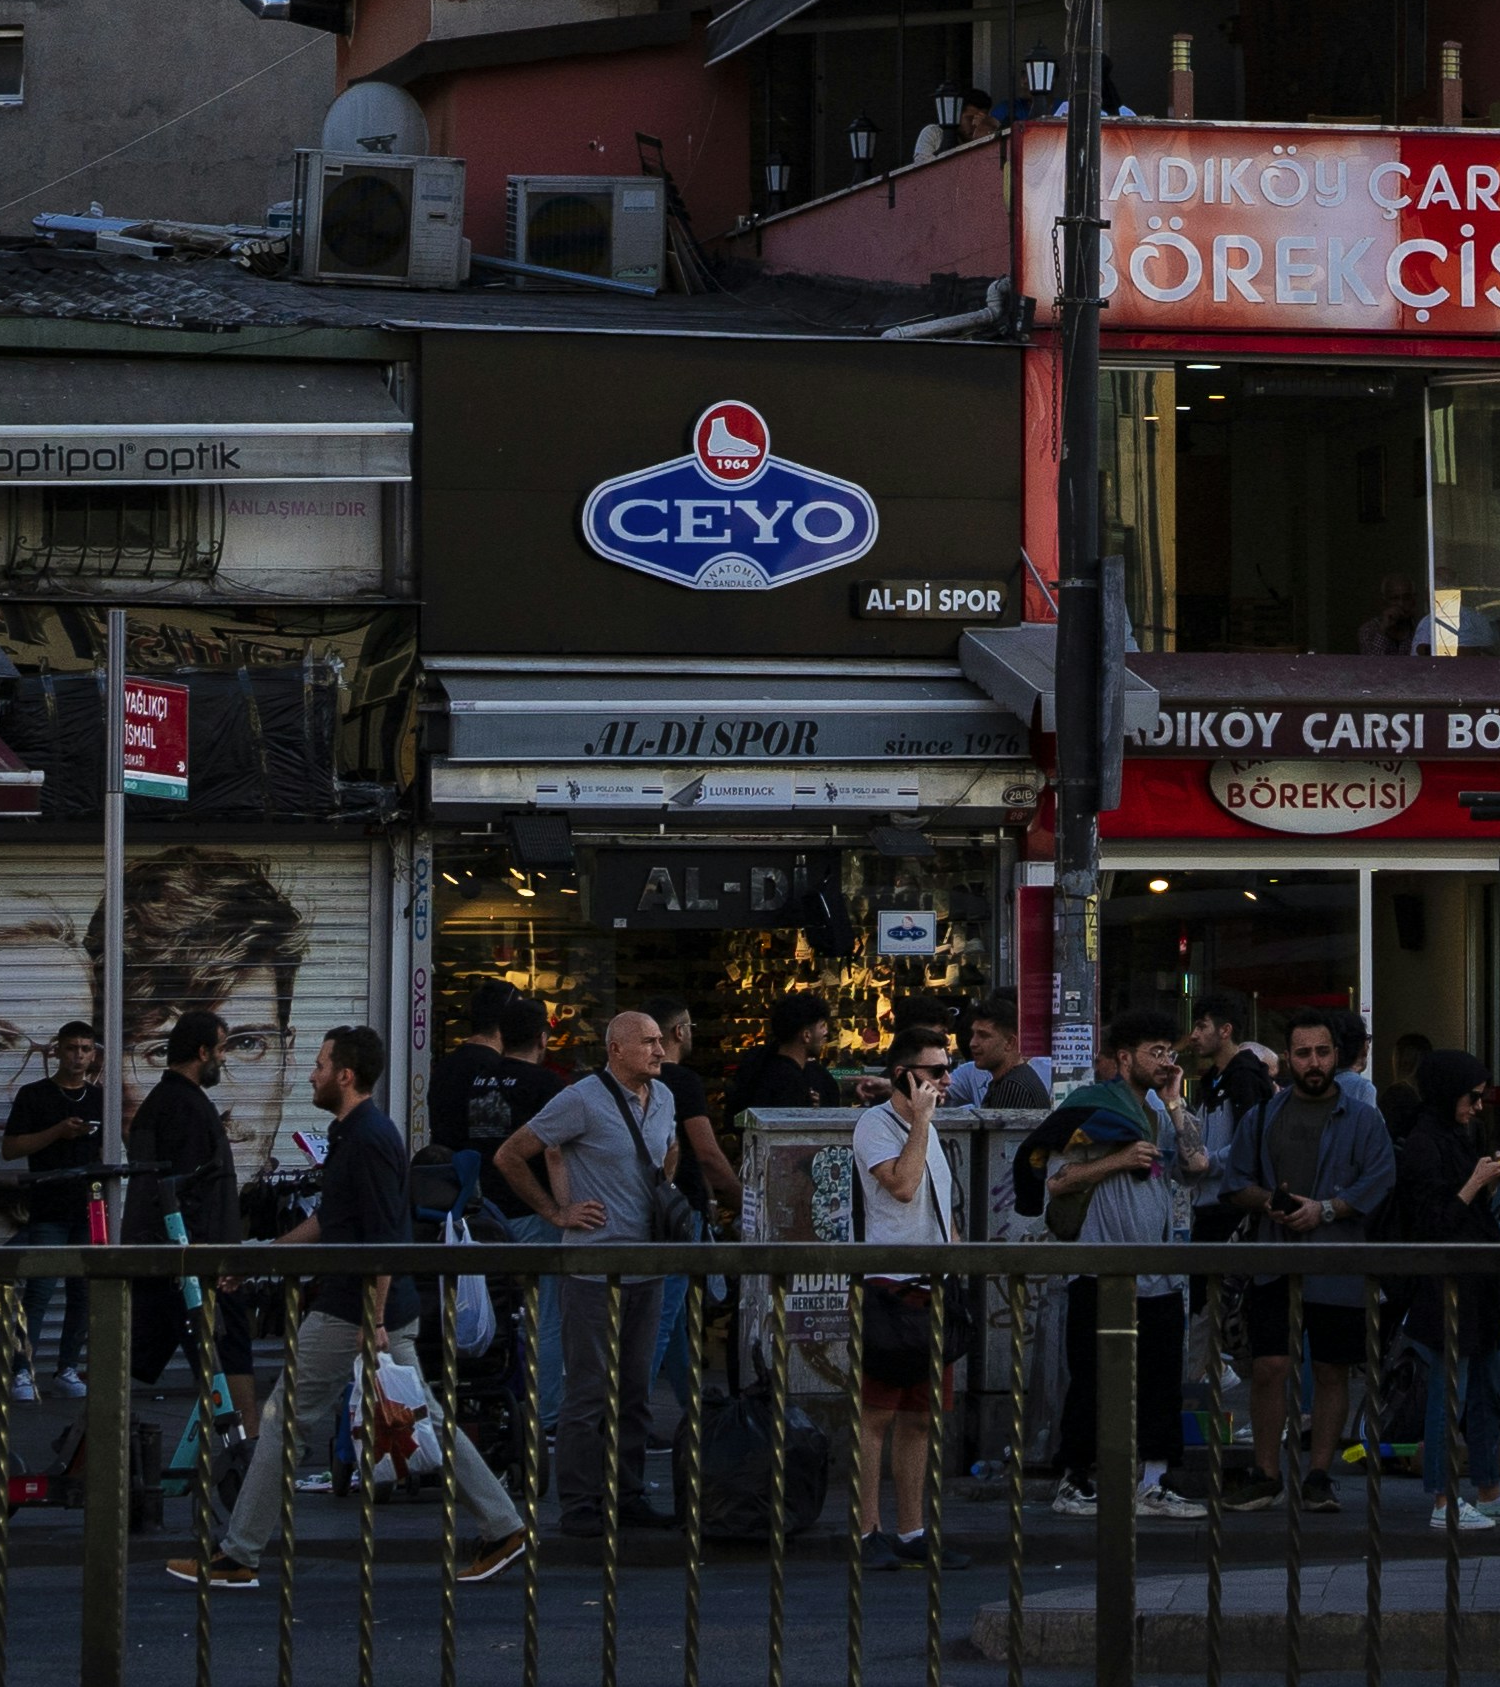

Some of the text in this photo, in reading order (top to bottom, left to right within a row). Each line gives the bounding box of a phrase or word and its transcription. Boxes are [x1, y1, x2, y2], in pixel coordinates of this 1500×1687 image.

[1107, 145, 1348, 207] ADIKÖY
[144, 442, 241, 476] optik
[717, 459, 749, 469] 1964
[227, 499, 366, 518] ANLAŞMALIDIR
[609, 499, 854, 544] CEYO
[713, 580, 752, 588] SANDALS
[866, 582, 1001, 612] AL-Dİ SPOR
[125, 689, 167, 722] YAĞLIKÇI
[125, 719, 157, 749] İSMAİL
[584, 715, 1020, 756] AL-Dİ SPOR since 1976
[1130, 706, 1283, 749] DIKÖY
[1301, 712, 1423, 753] ÇARŞI
[709, 787, 775, 796] LUMBERJACK
[1008, 790, 1034, 802] 28/B
[1227, 777, 1406, 813] BÖREKÇİSİ
[415, 859, 427, 941] CEYO
[888, 929, 926, 937] CEYO
[414, 968, 426, 1050] CEYO
[792, 1296, 825, 1310] HERKES
